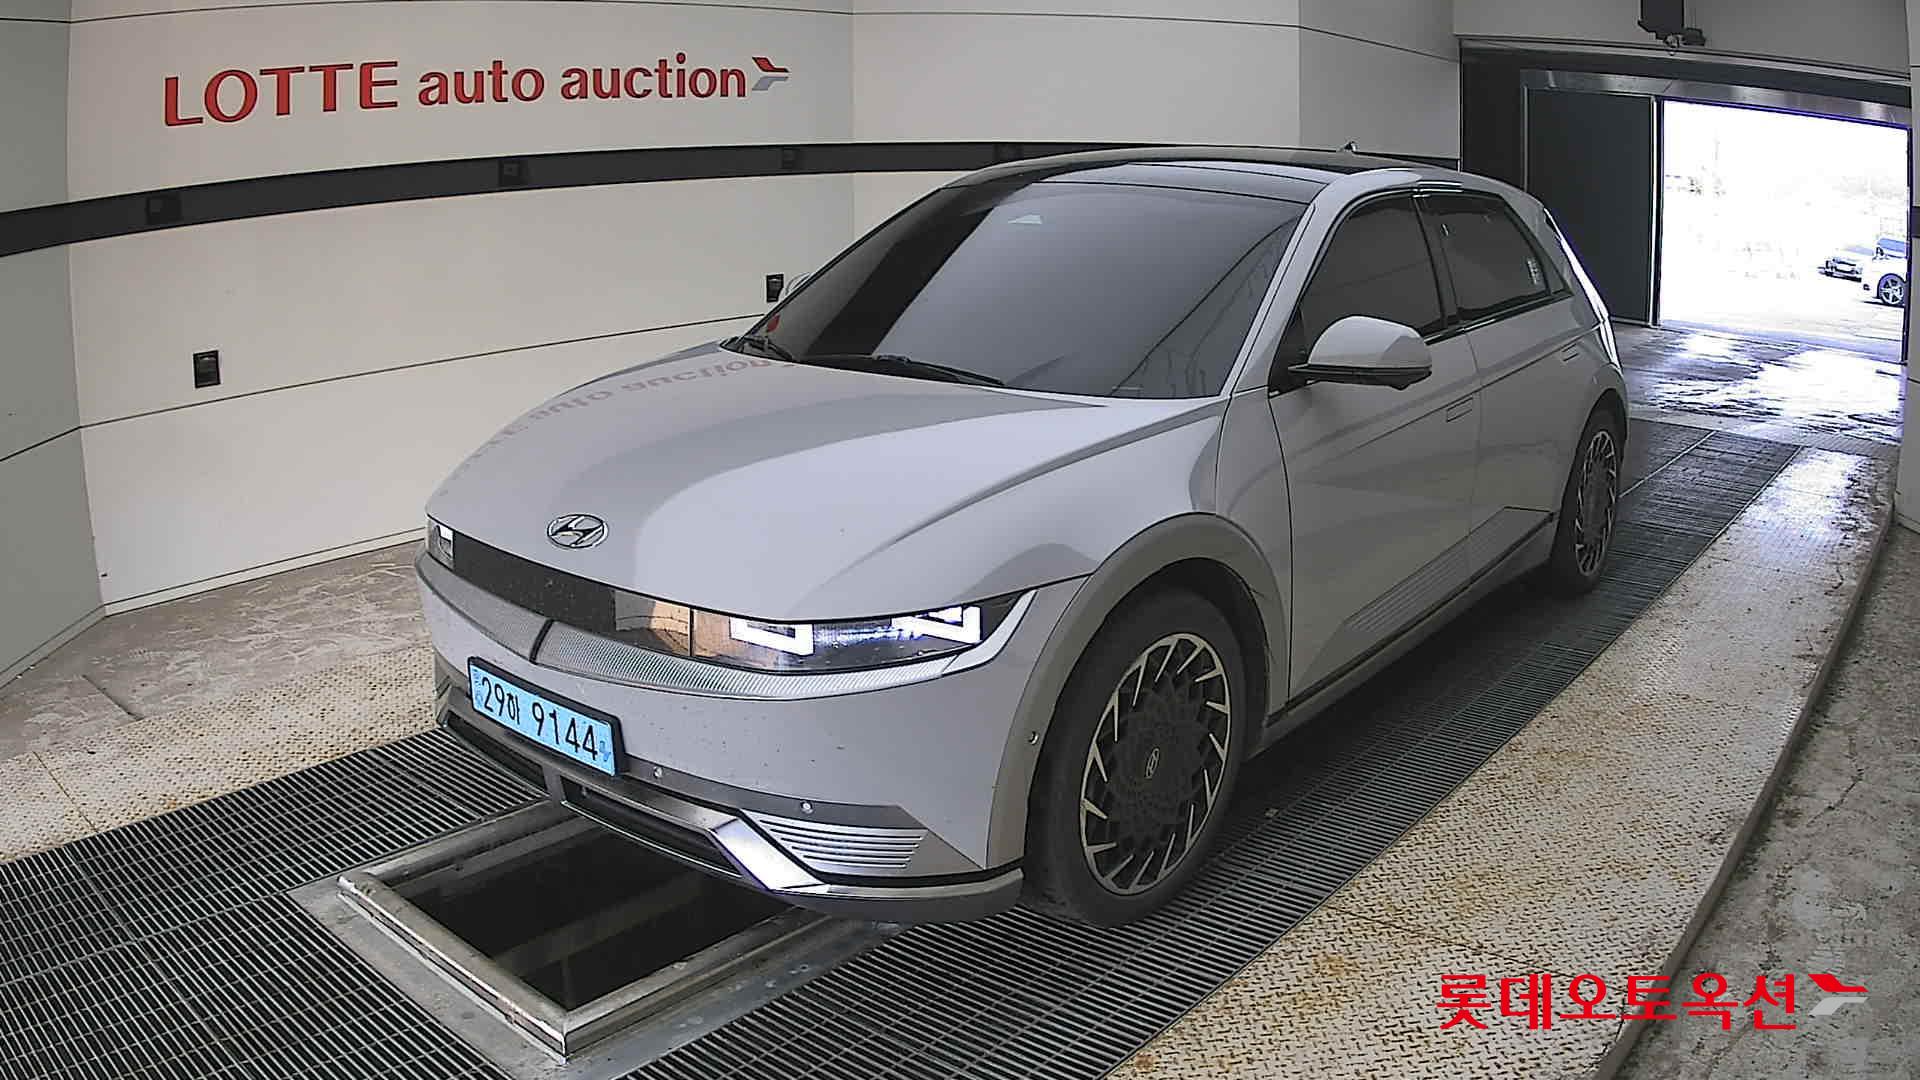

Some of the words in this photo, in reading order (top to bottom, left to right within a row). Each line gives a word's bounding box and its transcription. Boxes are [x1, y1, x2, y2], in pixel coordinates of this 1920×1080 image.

[164, 61, 398, 128] LOTTE
[418, 61, 544, 105] auto
[561, 53, 746, 99] auction
[532, 702, 598, 761] 9144
